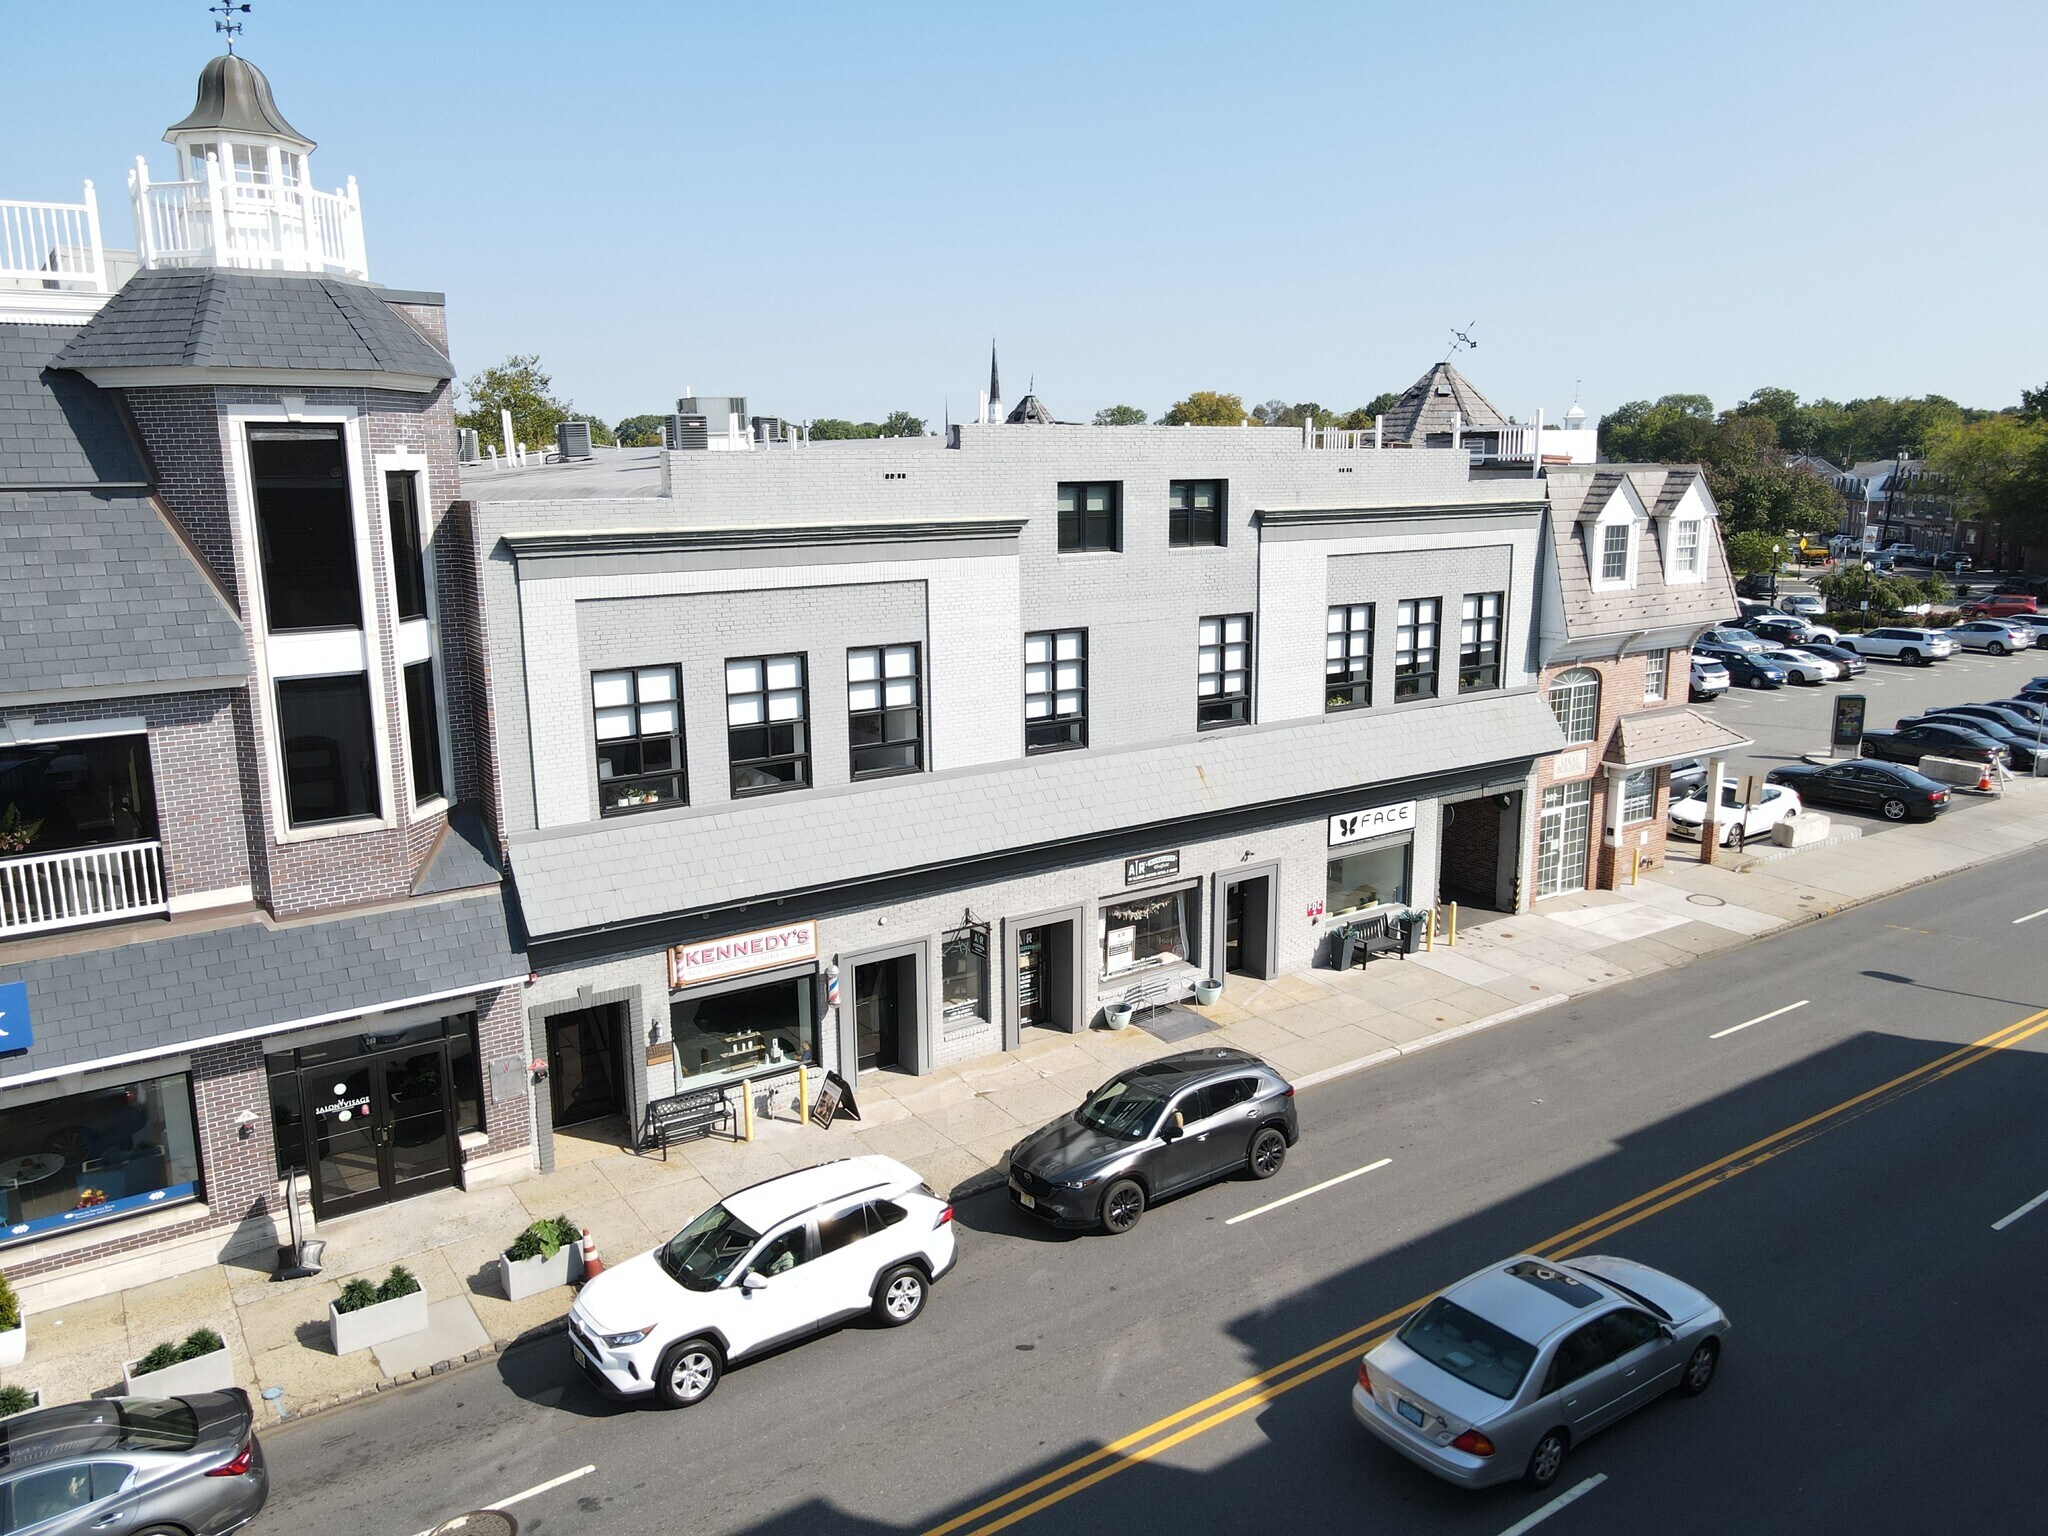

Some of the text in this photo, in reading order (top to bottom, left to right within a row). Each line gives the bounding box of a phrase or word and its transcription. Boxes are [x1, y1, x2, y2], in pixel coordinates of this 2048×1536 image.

[1360, 805, 1409, 828] FACE
[1308, 900, 1323, 912] FDC
[685, 928, 811, 967] KENNEDY'S
[365, 1037, 377, 1046] 240
